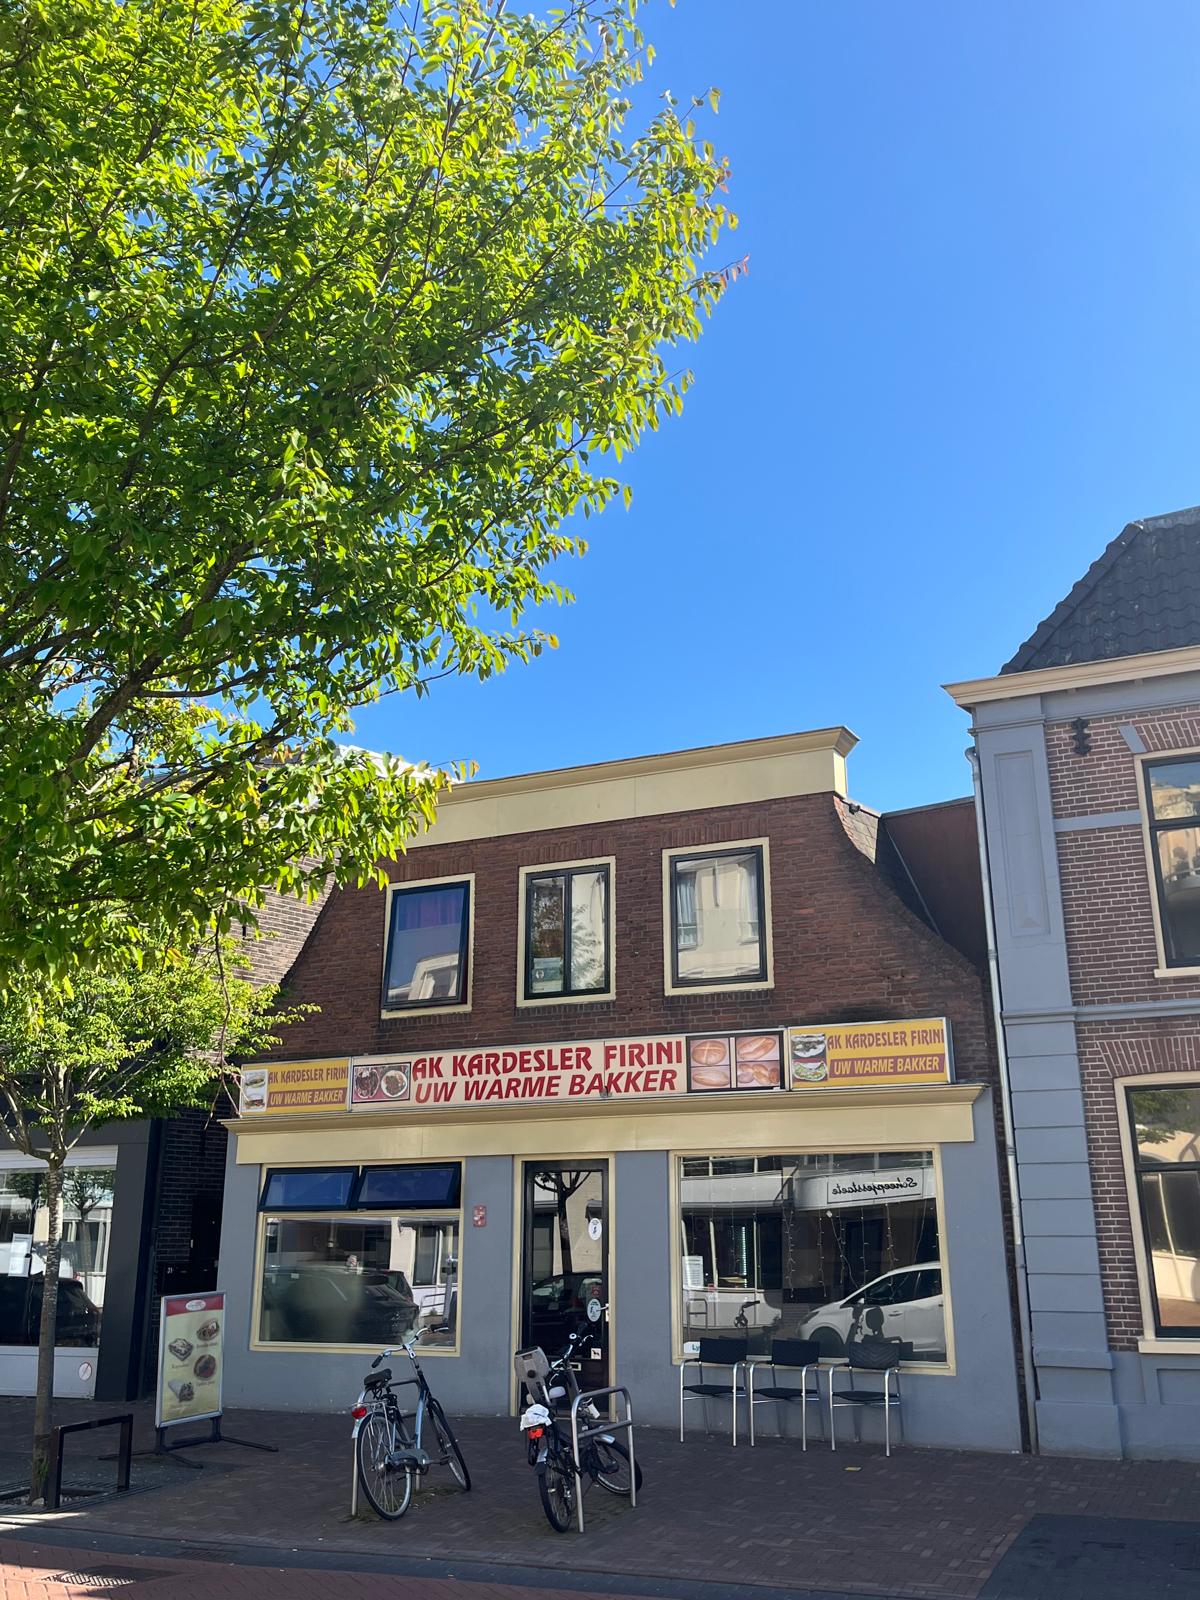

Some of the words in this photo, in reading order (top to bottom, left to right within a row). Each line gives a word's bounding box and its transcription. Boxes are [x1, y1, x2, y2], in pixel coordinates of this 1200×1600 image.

[826, 1034, 842, 1051] AK
[845, 1030, 908, 1050] KARDESLER
[910, 1028, 945, 1046] FIRINI
[412, 1056, 444, 1082] AK
[452, 1046, 593, 1079] KARDESLER
[604, 1040, 683, 1071] FIRINI
[834, 1061, 852, 1075] UW
[854, 1059, 894, 1074] WARME
[896, 1056, 940, 1072] BAKKER
[268, 1071, 279, 1084] AK
[280, 1067, 325, 1085] KARDESLER
[414, 1081, 457, 1104] UW
[463, 1075, 562, 1101] WARME
[568, 1069, 678, 1096] BAKKER
[270, 1092, 284, 1106] UW
[284, 1091, 313, 1105] WARME
[313, 1089, 344, 1104] BAKKER
